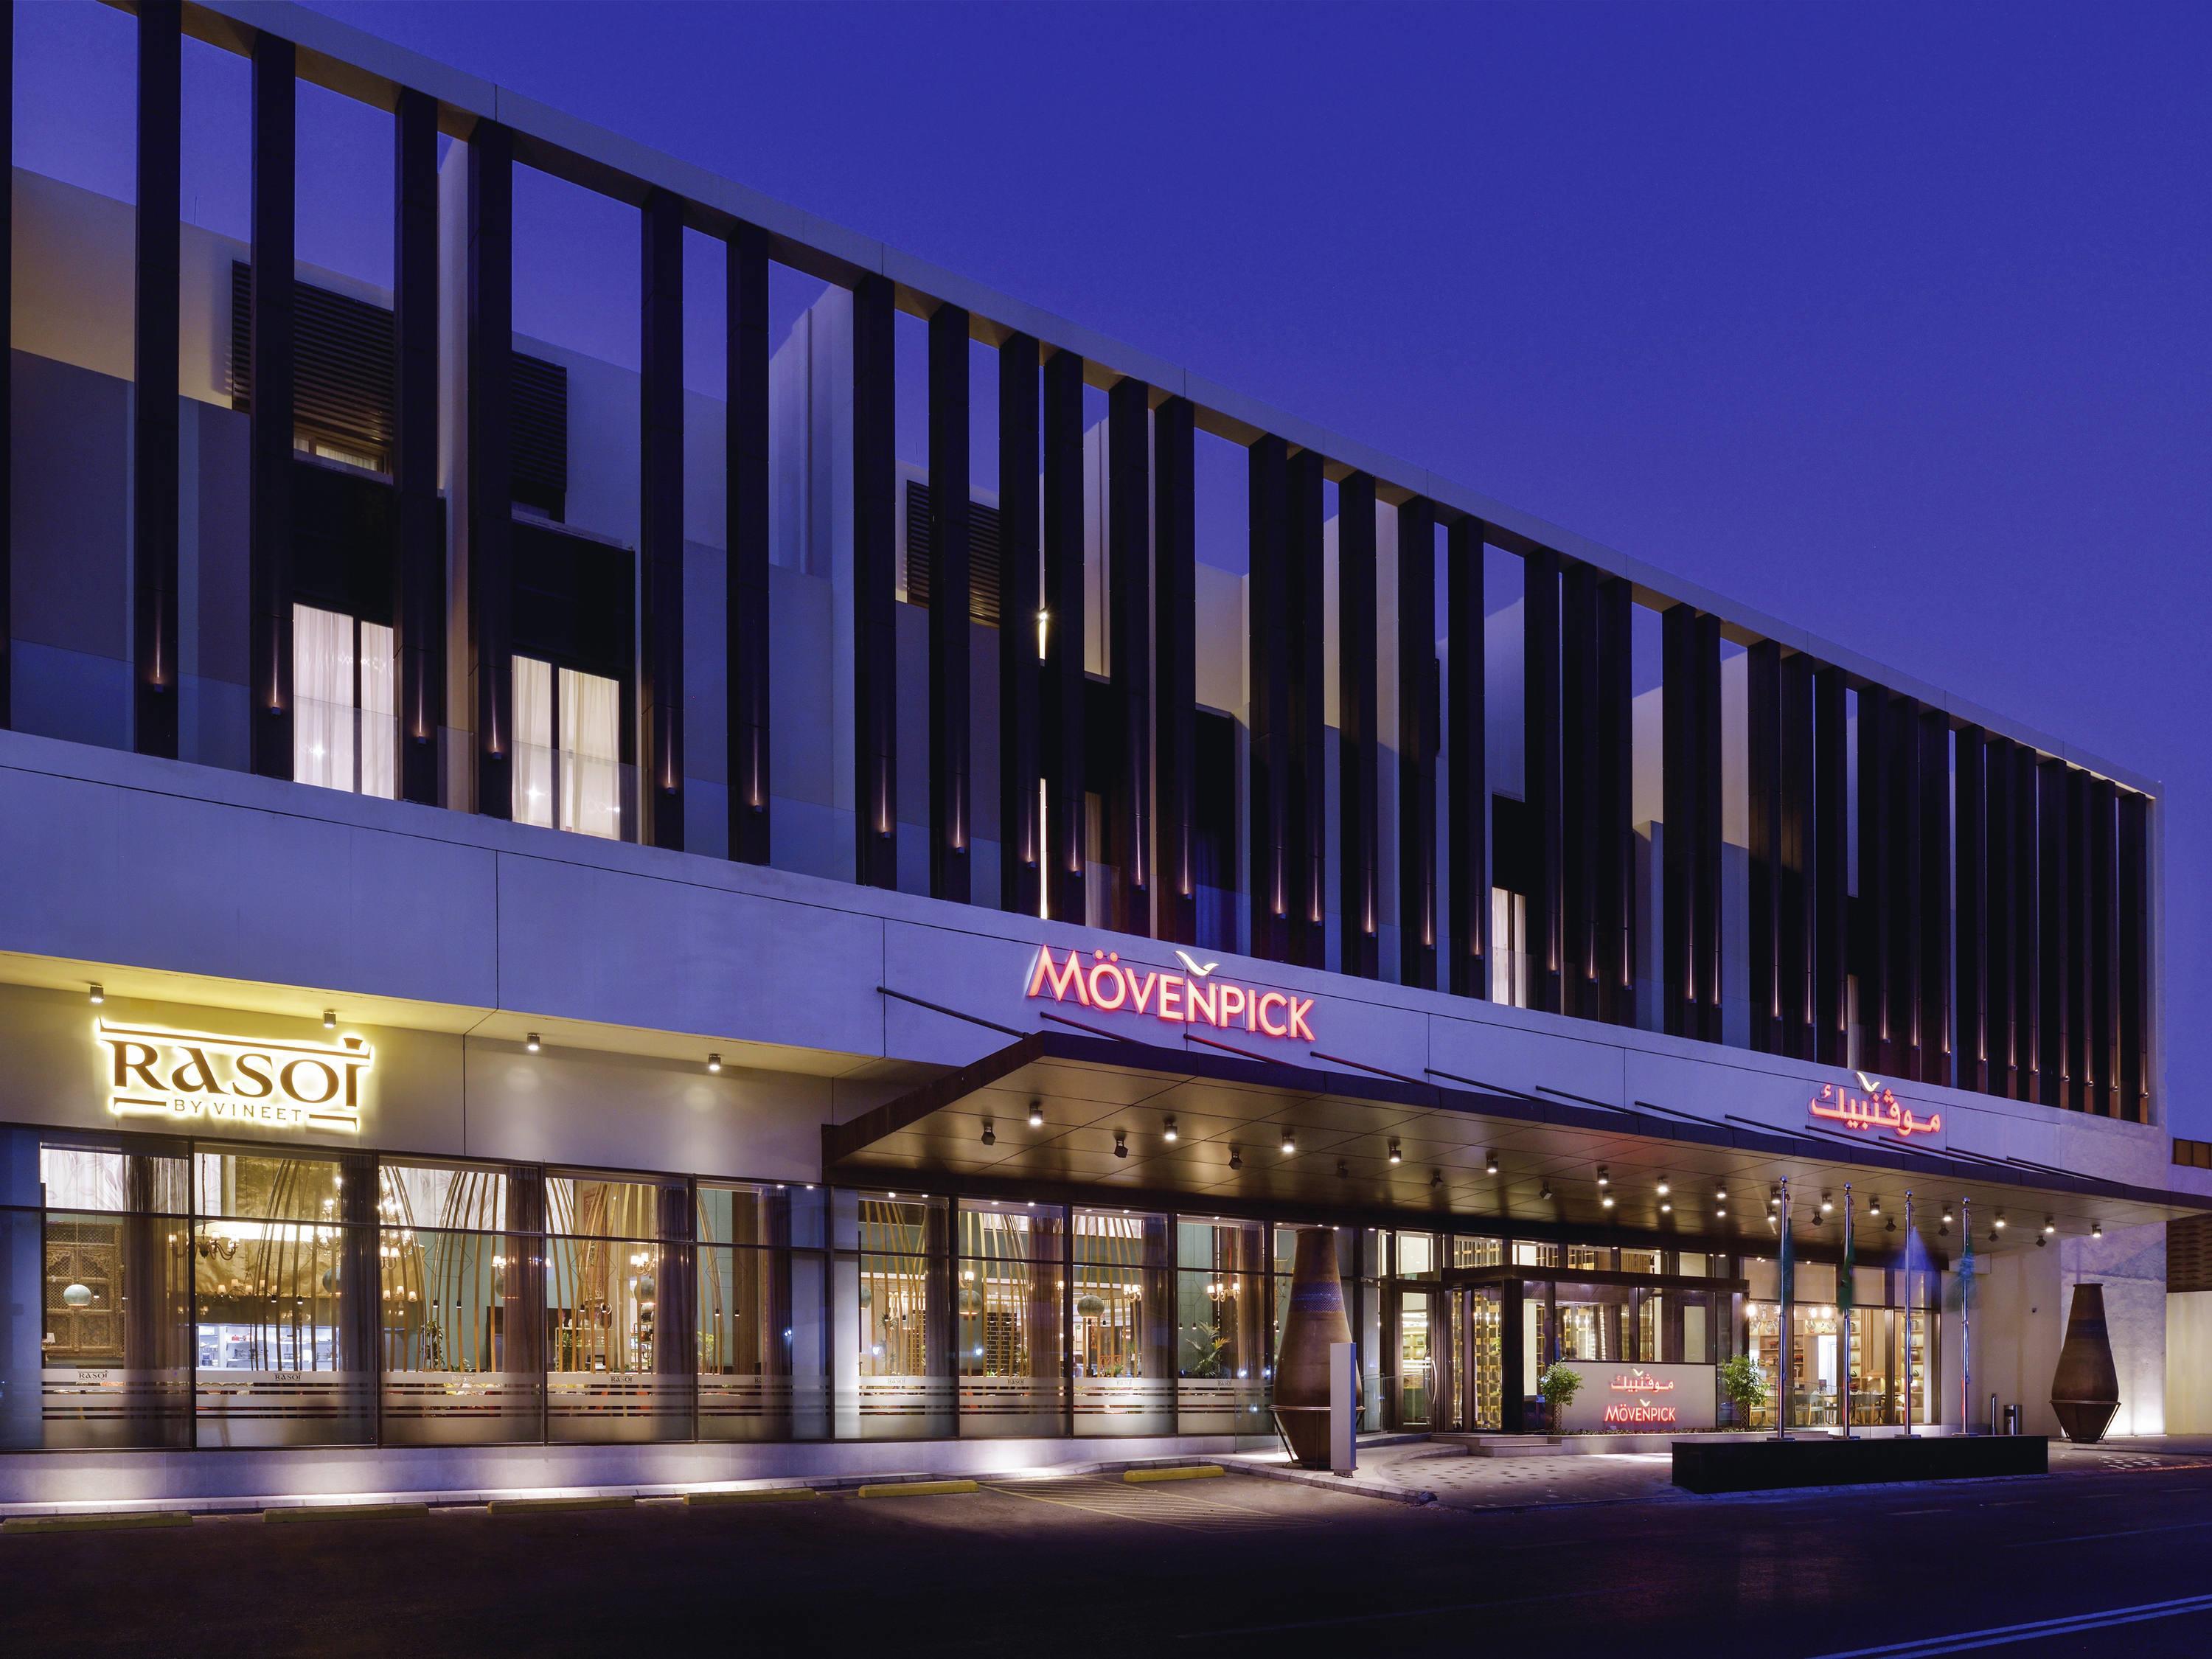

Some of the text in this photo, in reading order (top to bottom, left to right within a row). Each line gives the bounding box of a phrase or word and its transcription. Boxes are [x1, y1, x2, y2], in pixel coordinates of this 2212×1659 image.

[1027, 944, 1315, 1041] MÖVENPICK
[174, 1099, 302, 1122] BY VINEET
[78, 1370, 108, 1379] RASOI
[274, 1372, 301, 1380] RASOI
[1604, 1403, 1677, 1422] MÖVENPICK
